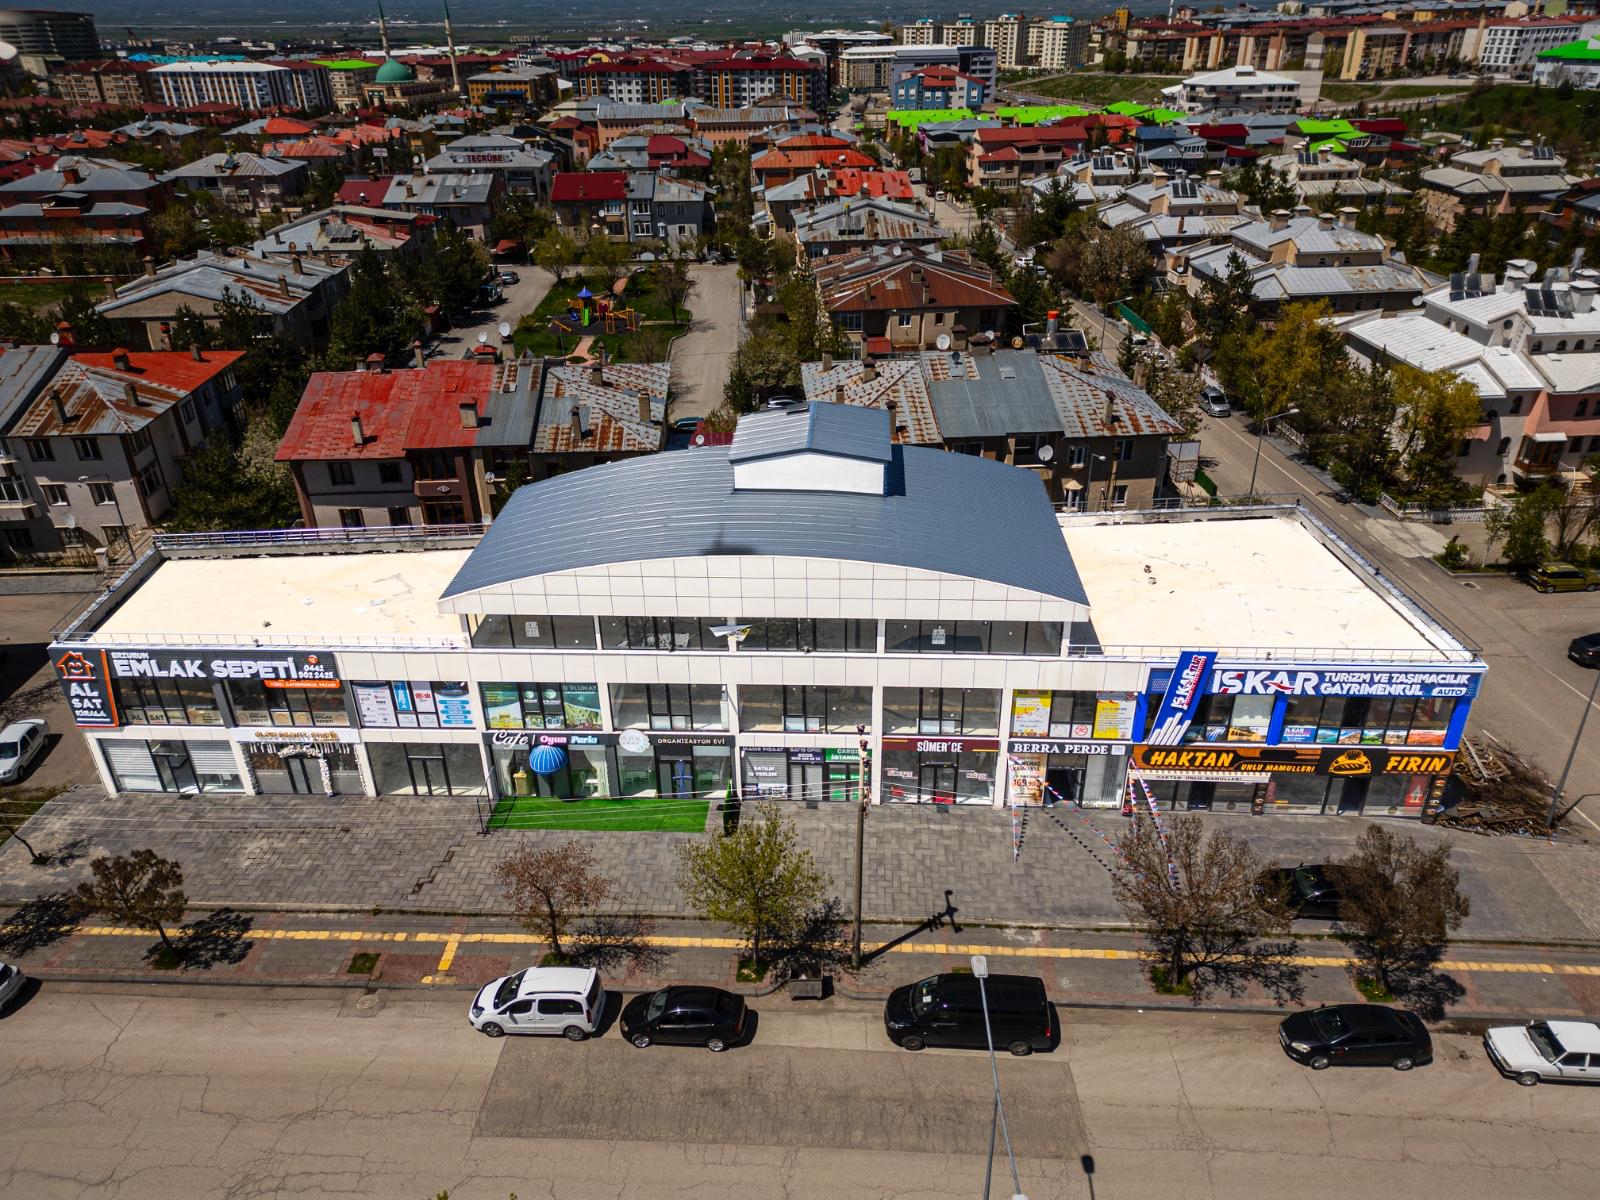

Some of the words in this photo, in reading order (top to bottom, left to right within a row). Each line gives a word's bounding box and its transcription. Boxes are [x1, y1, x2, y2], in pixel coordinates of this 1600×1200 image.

[113, 659, 207, 678] EMLAK
[210, 657, 298, 679] SEPETİ
[303, 664, 325, 672] 0442
[298, 671, 314, 679] 502
[314, 671, 334, 679] 2425
[1373, 673, 1390, 683] VE
[70, 683, 99, 697] AL
[71, 698, 103, 709] SAT
[540, 735, 567, 745] Oyun
[1013, 743, 1060, 754] BERRA
[1063, 745, 1109, 755] PERDE
[1150, 751, 1234, 767] HAKTAN
[1385, 756, 1447, 772] FIRIN
